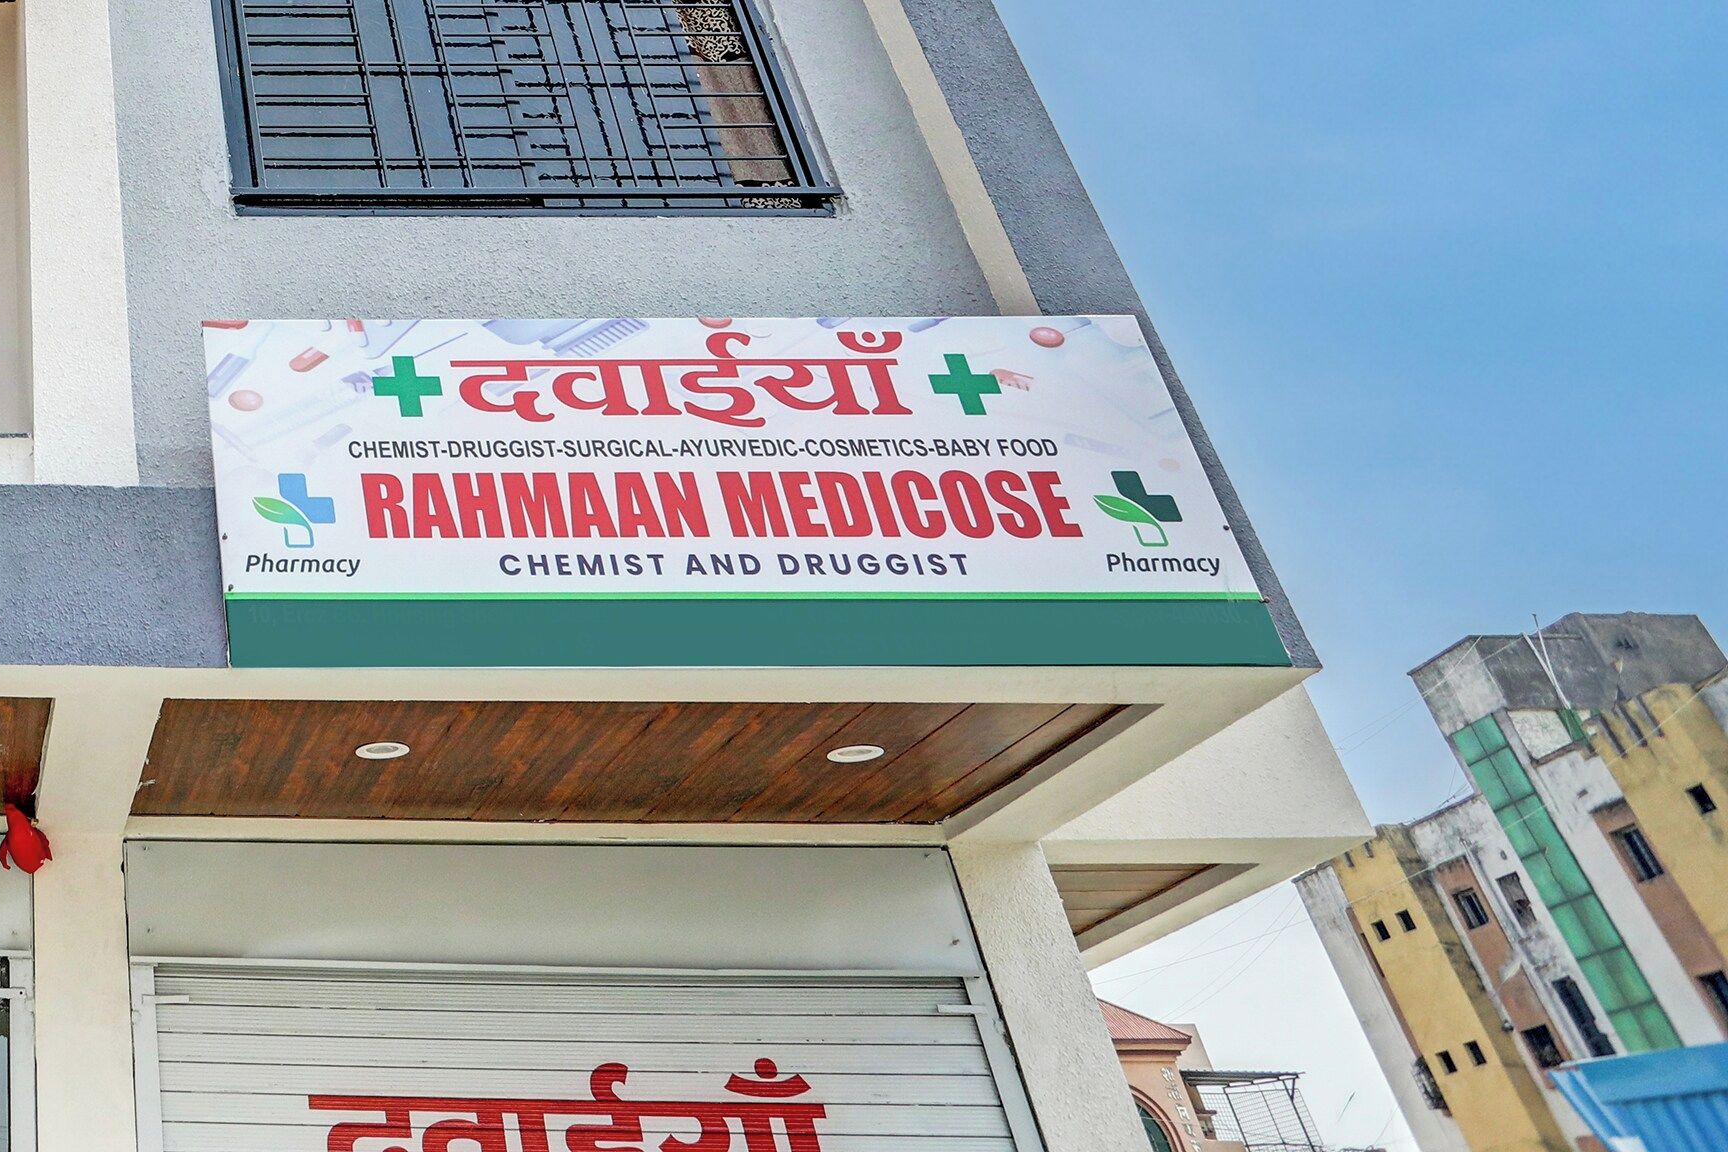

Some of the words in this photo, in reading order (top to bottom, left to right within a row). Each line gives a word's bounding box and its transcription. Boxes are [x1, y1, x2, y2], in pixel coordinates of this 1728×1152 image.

[450, 330, 913, 428] दवाईयाँ
[995, 438, 1059, 458] FOOD
[362, 471, 710, 539] RAHMAAN
[718, 470, 1083, 539] MEDICOSE
[245, 552, 362, 579] Pharmacy
[499, 553, 666, 577] CHEMIST
[685, 553, 762, 577] AND
[776, 553, 969, 577] DRUGGIST
[1106, 551, 1222, 578] Pharmacy
